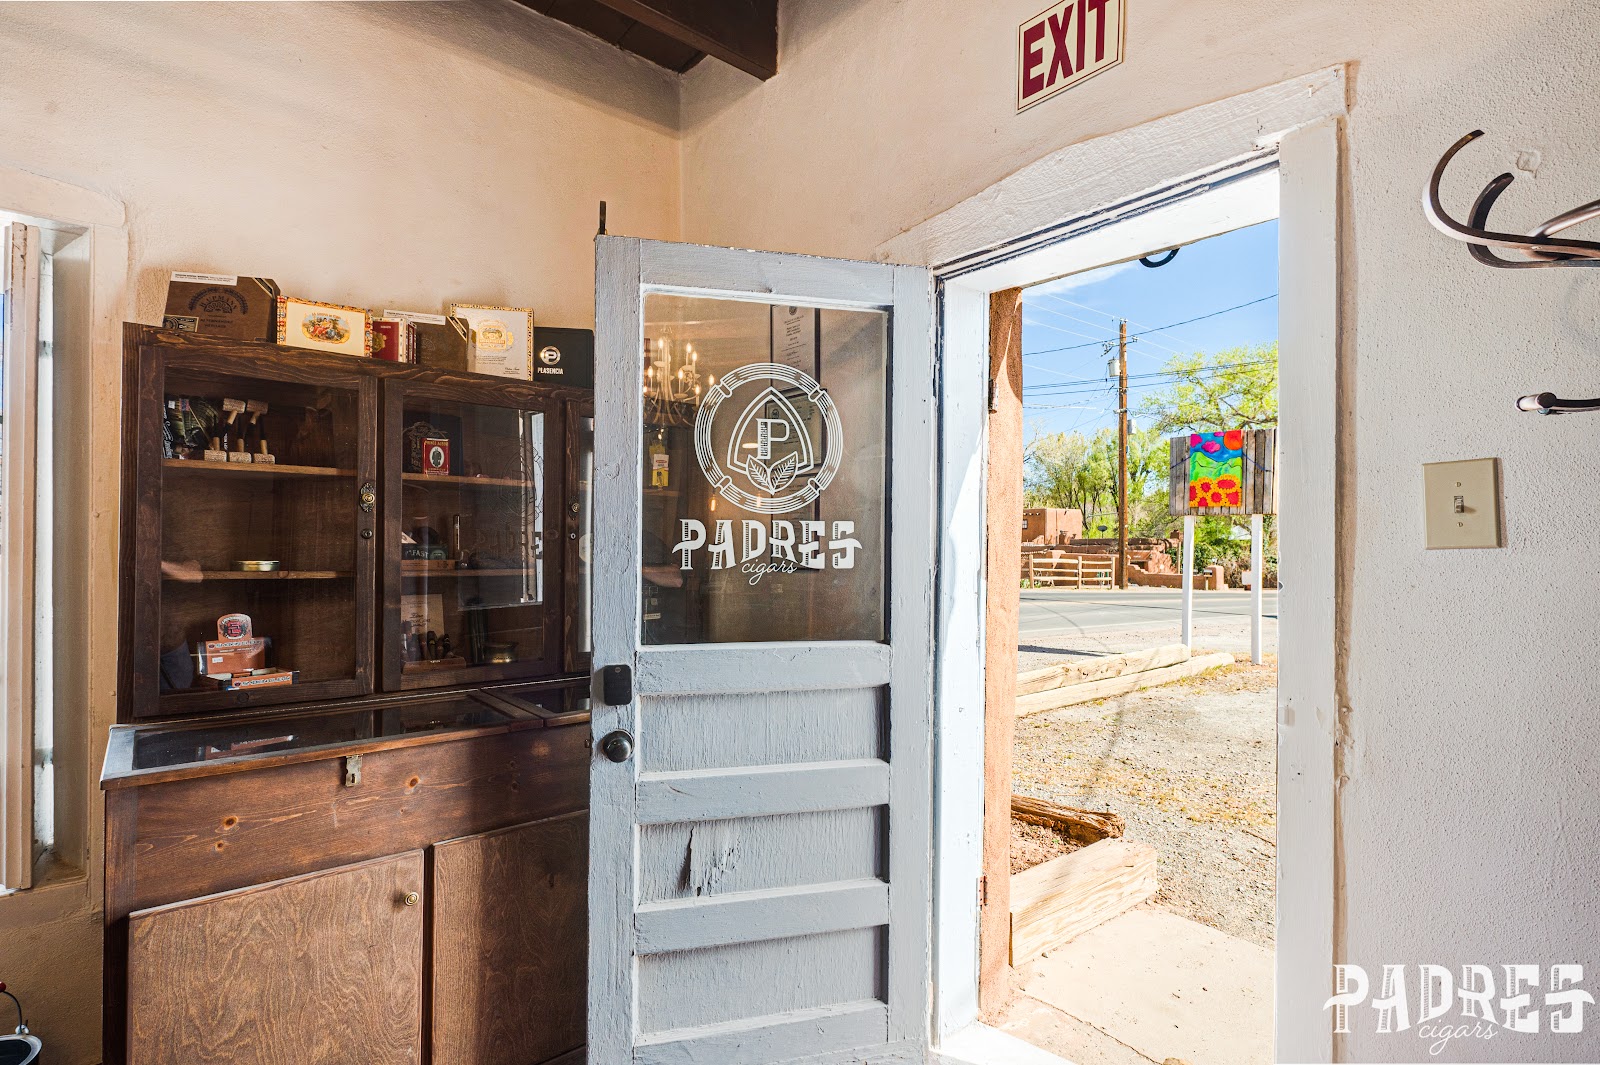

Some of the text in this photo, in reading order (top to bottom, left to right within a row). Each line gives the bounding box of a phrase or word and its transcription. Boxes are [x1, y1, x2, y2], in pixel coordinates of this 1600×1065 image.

[1022, 0, 1110, 100] EXIT
[537, 367, 564, 375] PLASENCIA
[756, 418, 790, 460] P
[671, 518, 863, 571] PADRES
[740, 558, 798, 586] cigars
